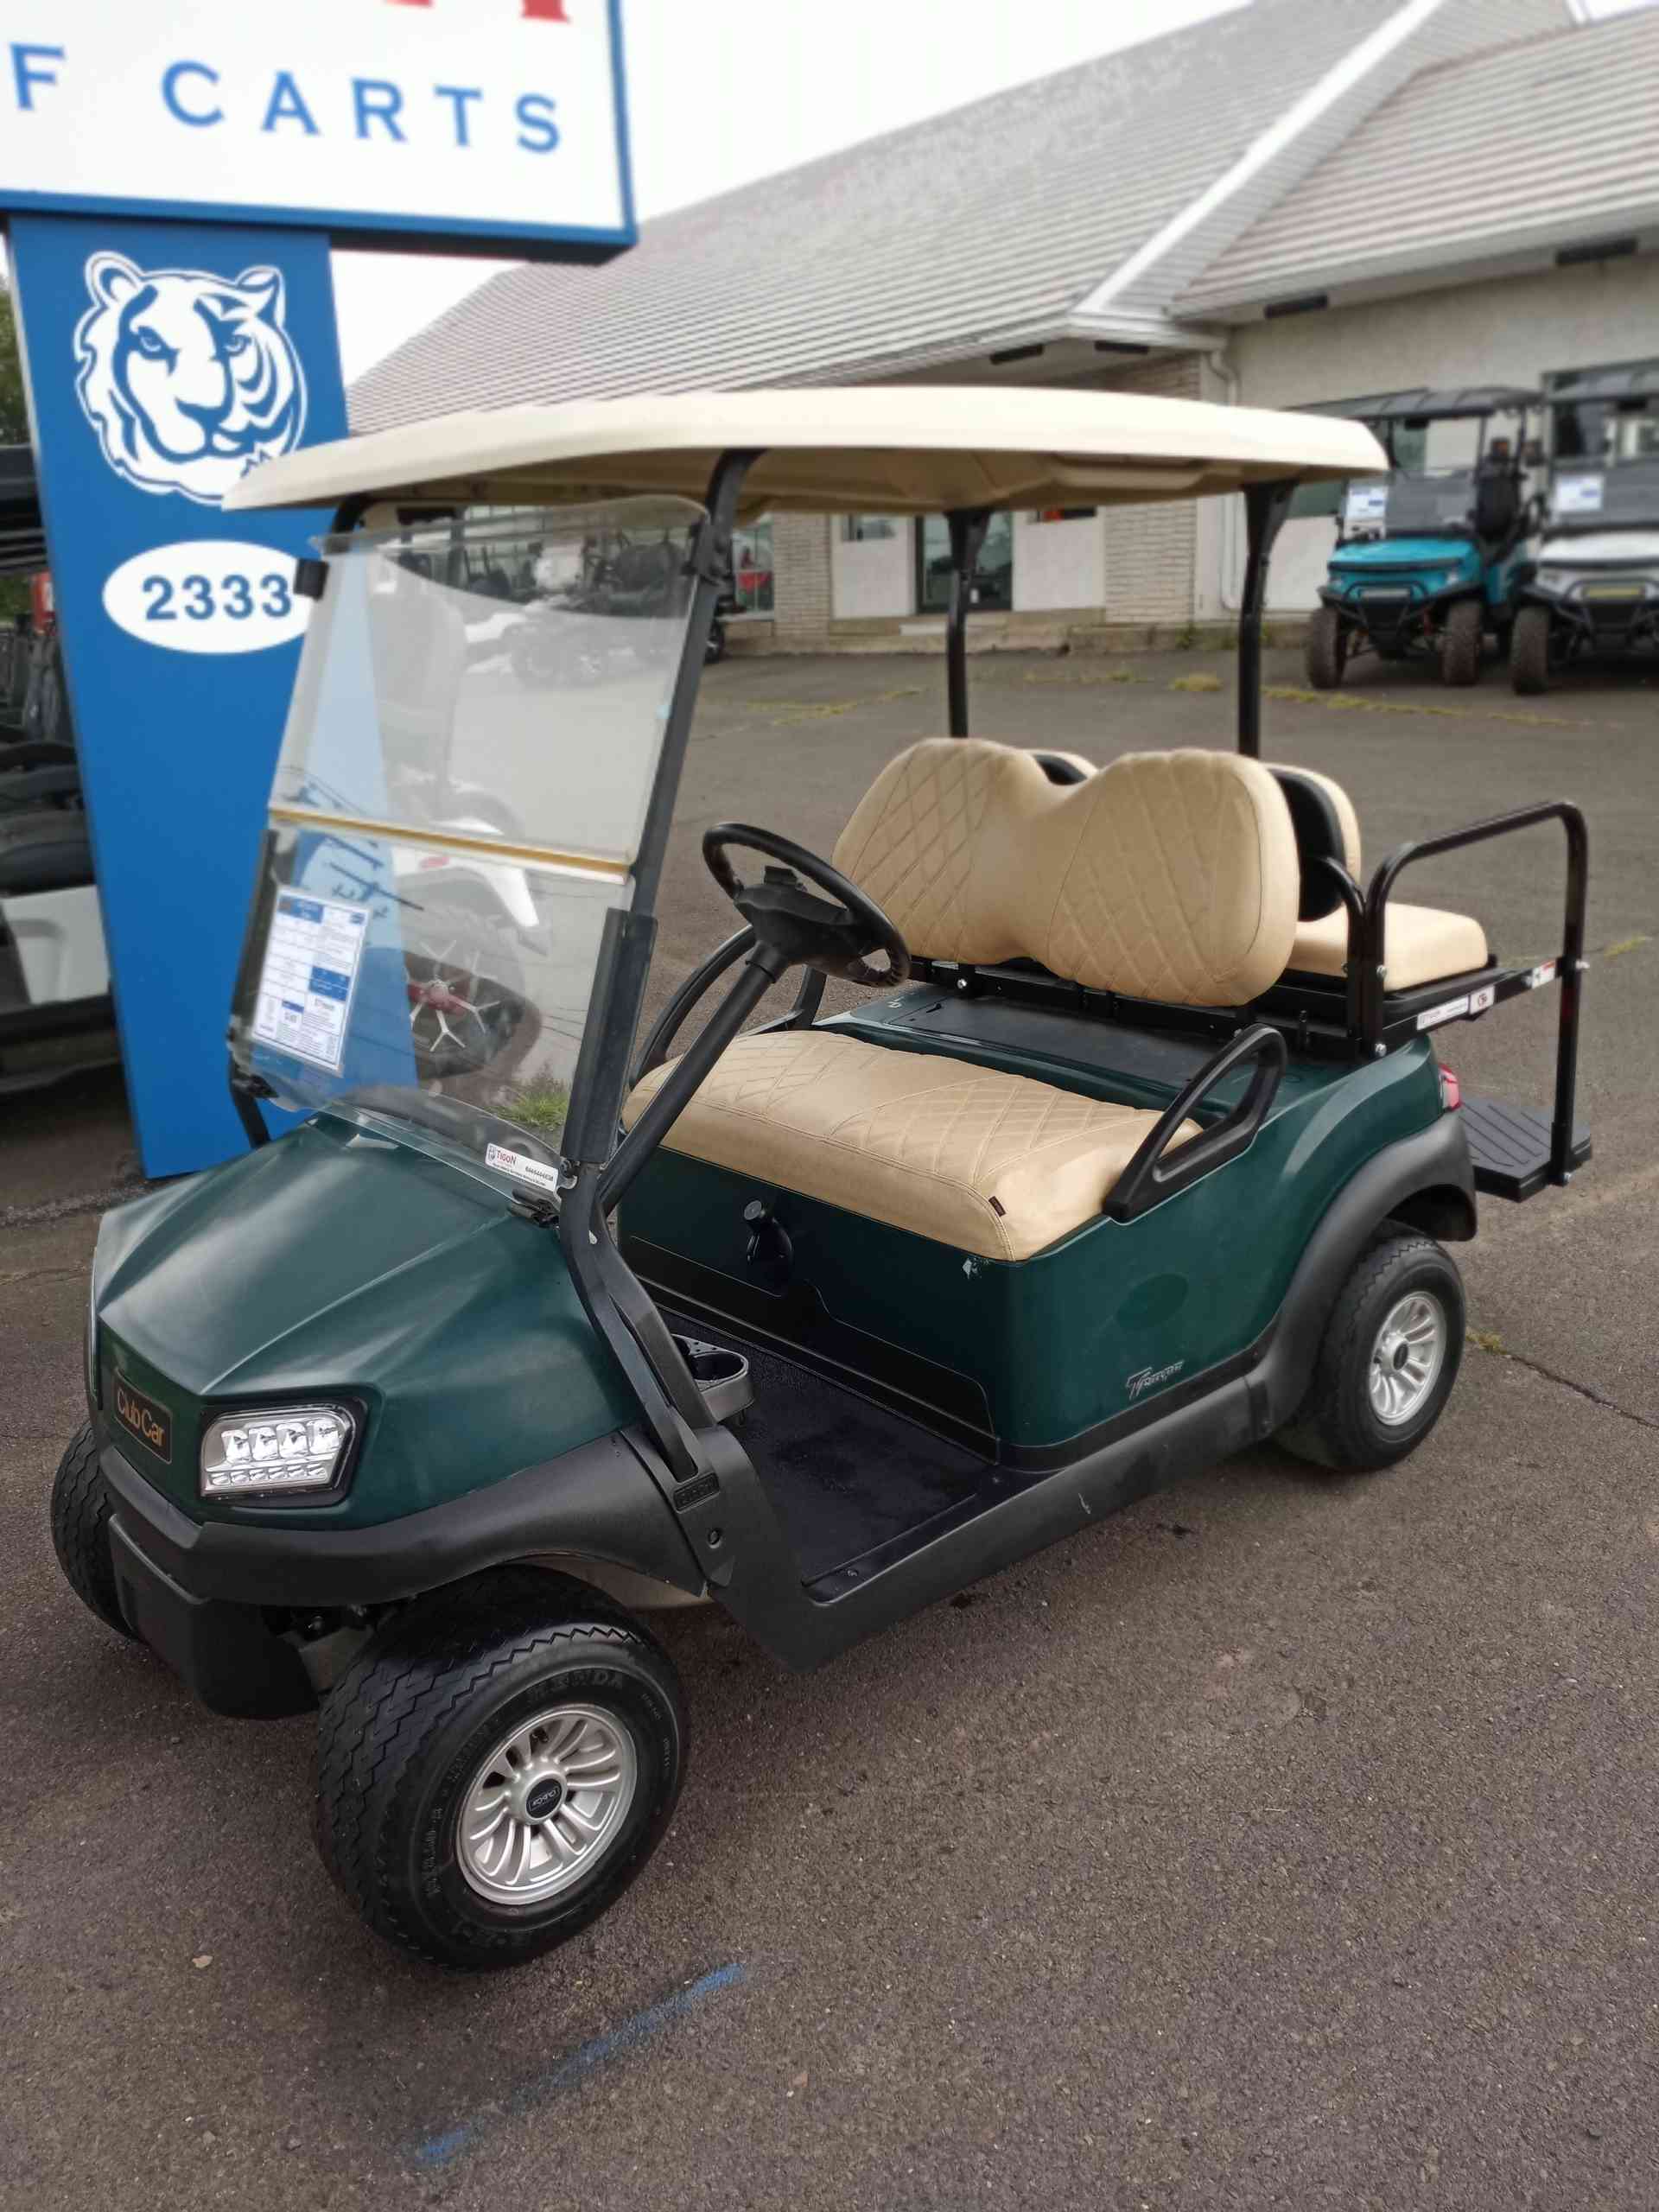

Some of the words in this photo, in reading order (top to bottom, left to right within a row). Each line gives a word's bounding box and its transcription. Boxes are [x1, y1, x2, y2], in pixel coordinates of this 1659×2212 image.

[10, 42, 66, 111] F
[162, 60, 561, 154] CARTS
[142, 574, 292, 620] 2333
